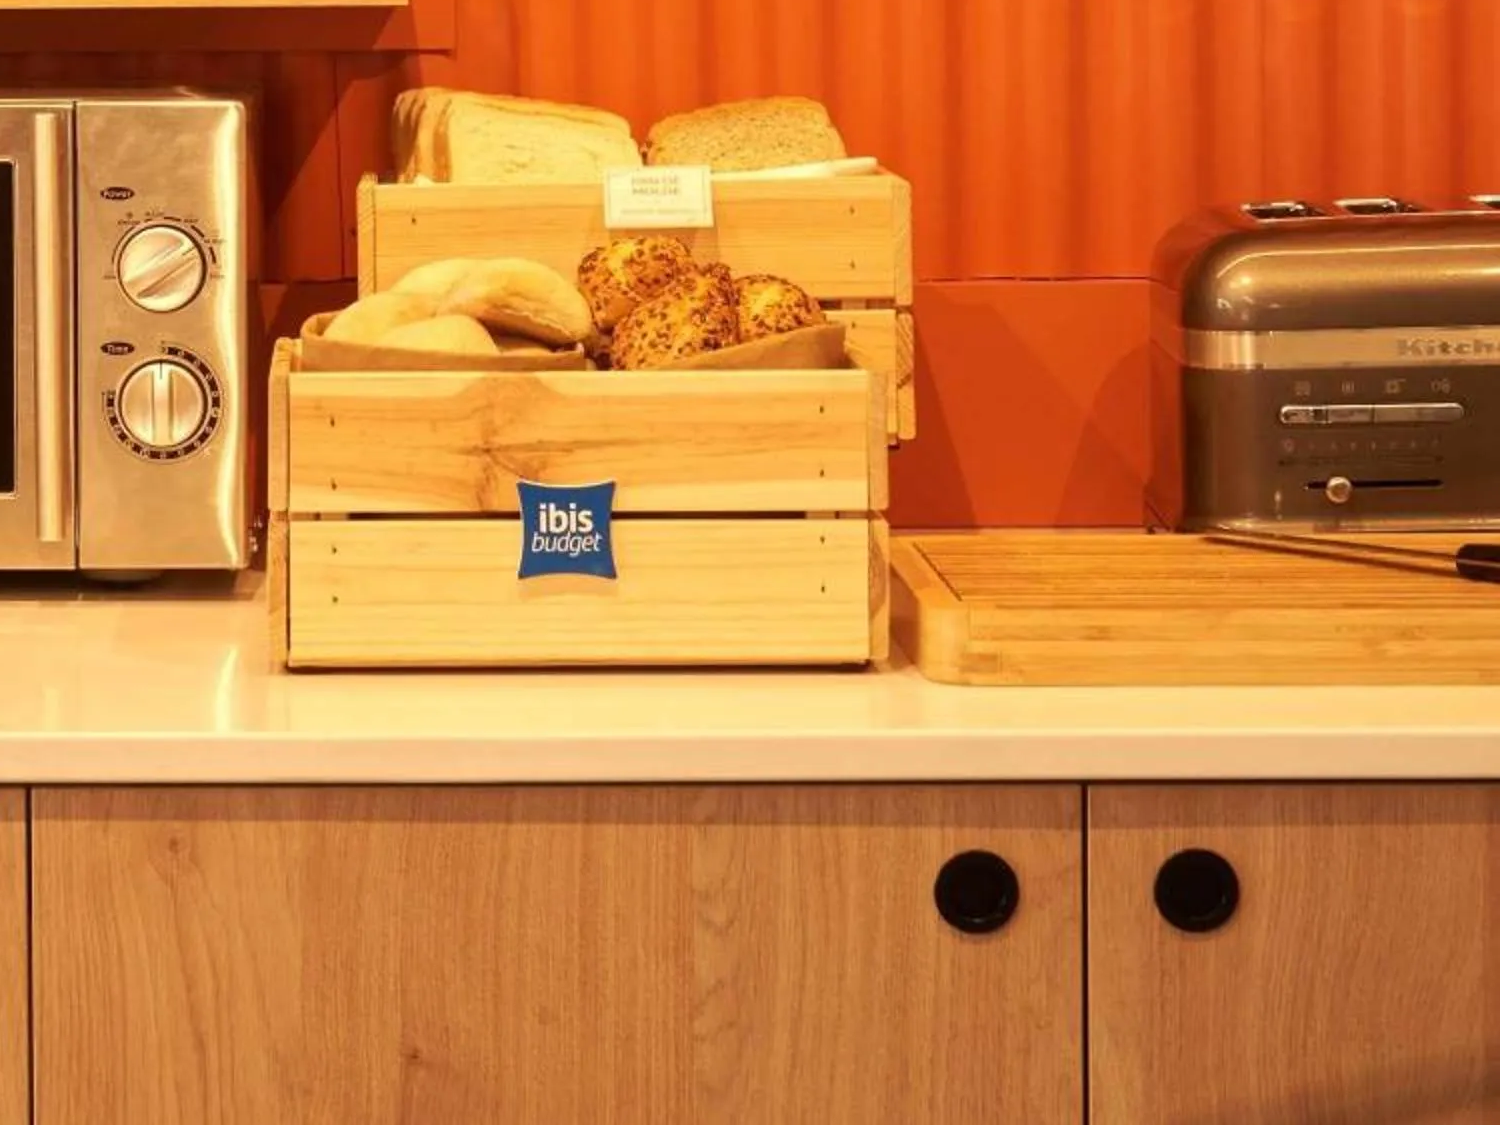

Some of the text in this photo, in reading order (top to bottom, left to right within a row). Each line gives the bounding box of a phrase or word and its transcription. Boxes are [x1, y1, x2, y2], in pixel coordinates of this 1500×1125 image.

[1397, 339, 1500, 355] Kitch
[539, 502, 594, 533] ibis
[531, 531, 603, 557] budget
